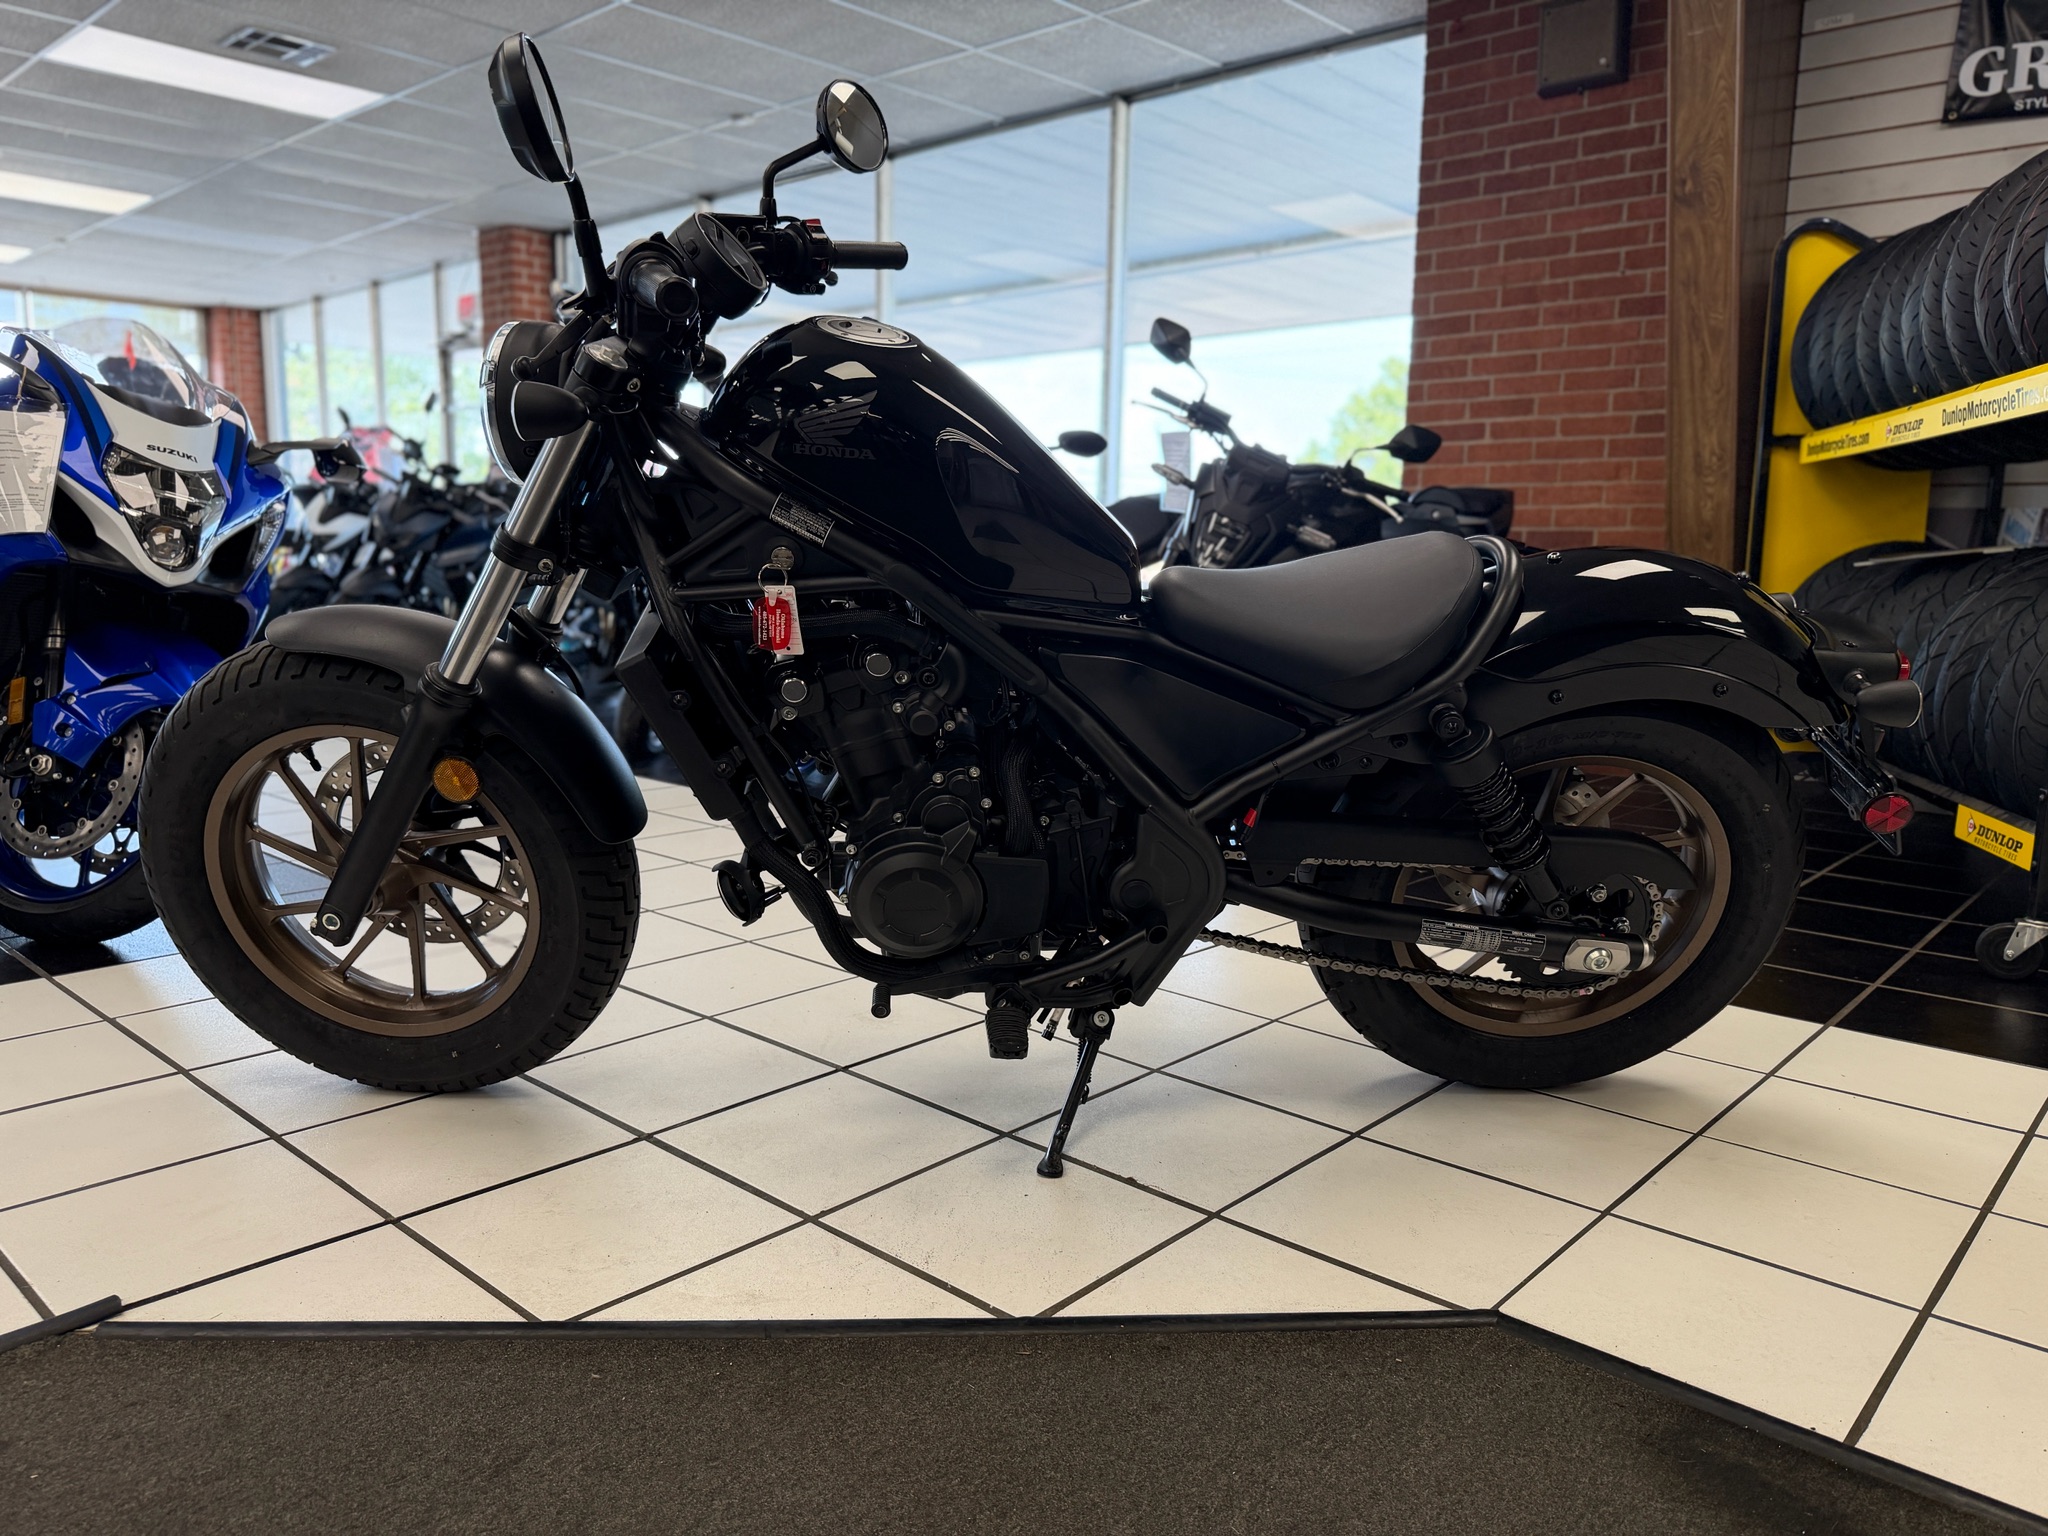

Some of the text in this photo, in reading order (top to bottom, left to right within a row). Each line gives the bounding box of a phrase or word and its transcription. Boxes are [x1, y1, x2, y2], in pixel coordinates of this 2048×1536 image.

[1892, 418, 1924, 435] DUNLOP
[146, 444, 198, 463] SUZUKI
[793, 443, 877, 460] HONDA
[1976, 824, 2024, 853] DUNLOP
[1974, 836, 2018, 861] MOTORCYCLE TIRES
